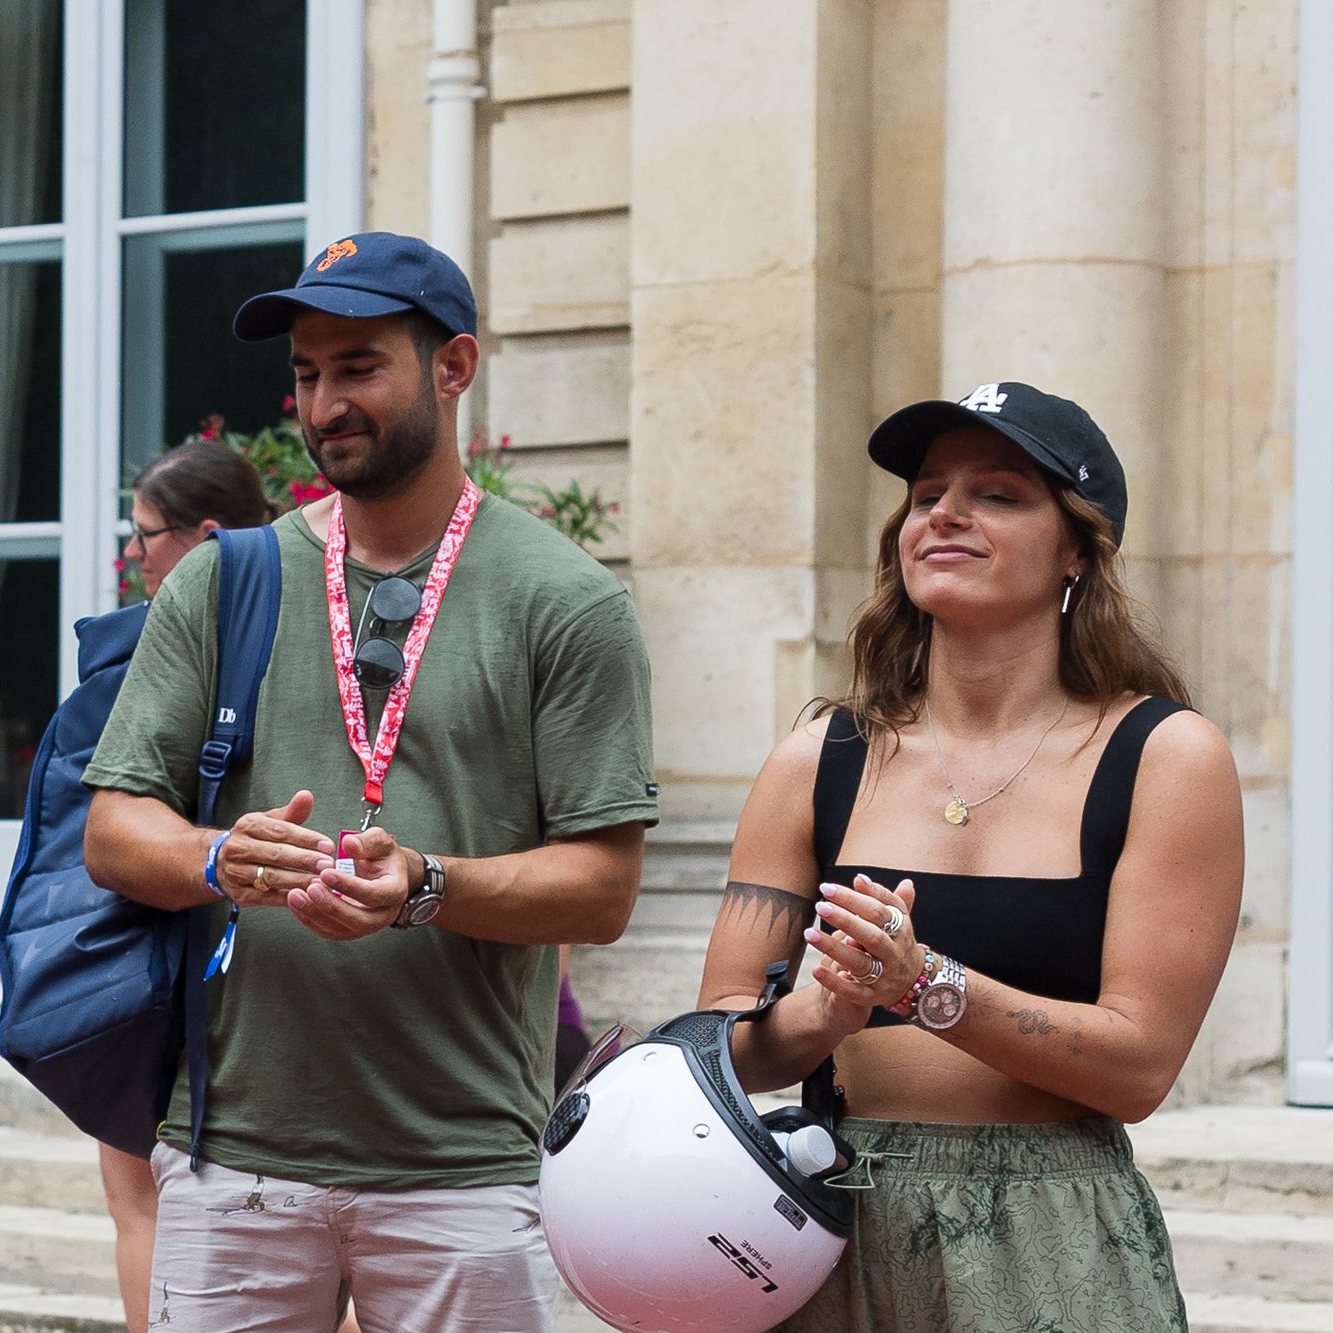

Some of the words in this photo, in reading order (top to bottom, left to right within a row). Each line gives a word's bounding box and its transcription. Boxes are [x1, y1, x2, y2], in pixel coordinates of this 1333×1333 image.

[959, 383, 1008, 413] LA
[218, 707, 237, 724] Db
[707, 1232, 779, 1294] LS2
[740, 1239, 773, 1271] SPHERE
